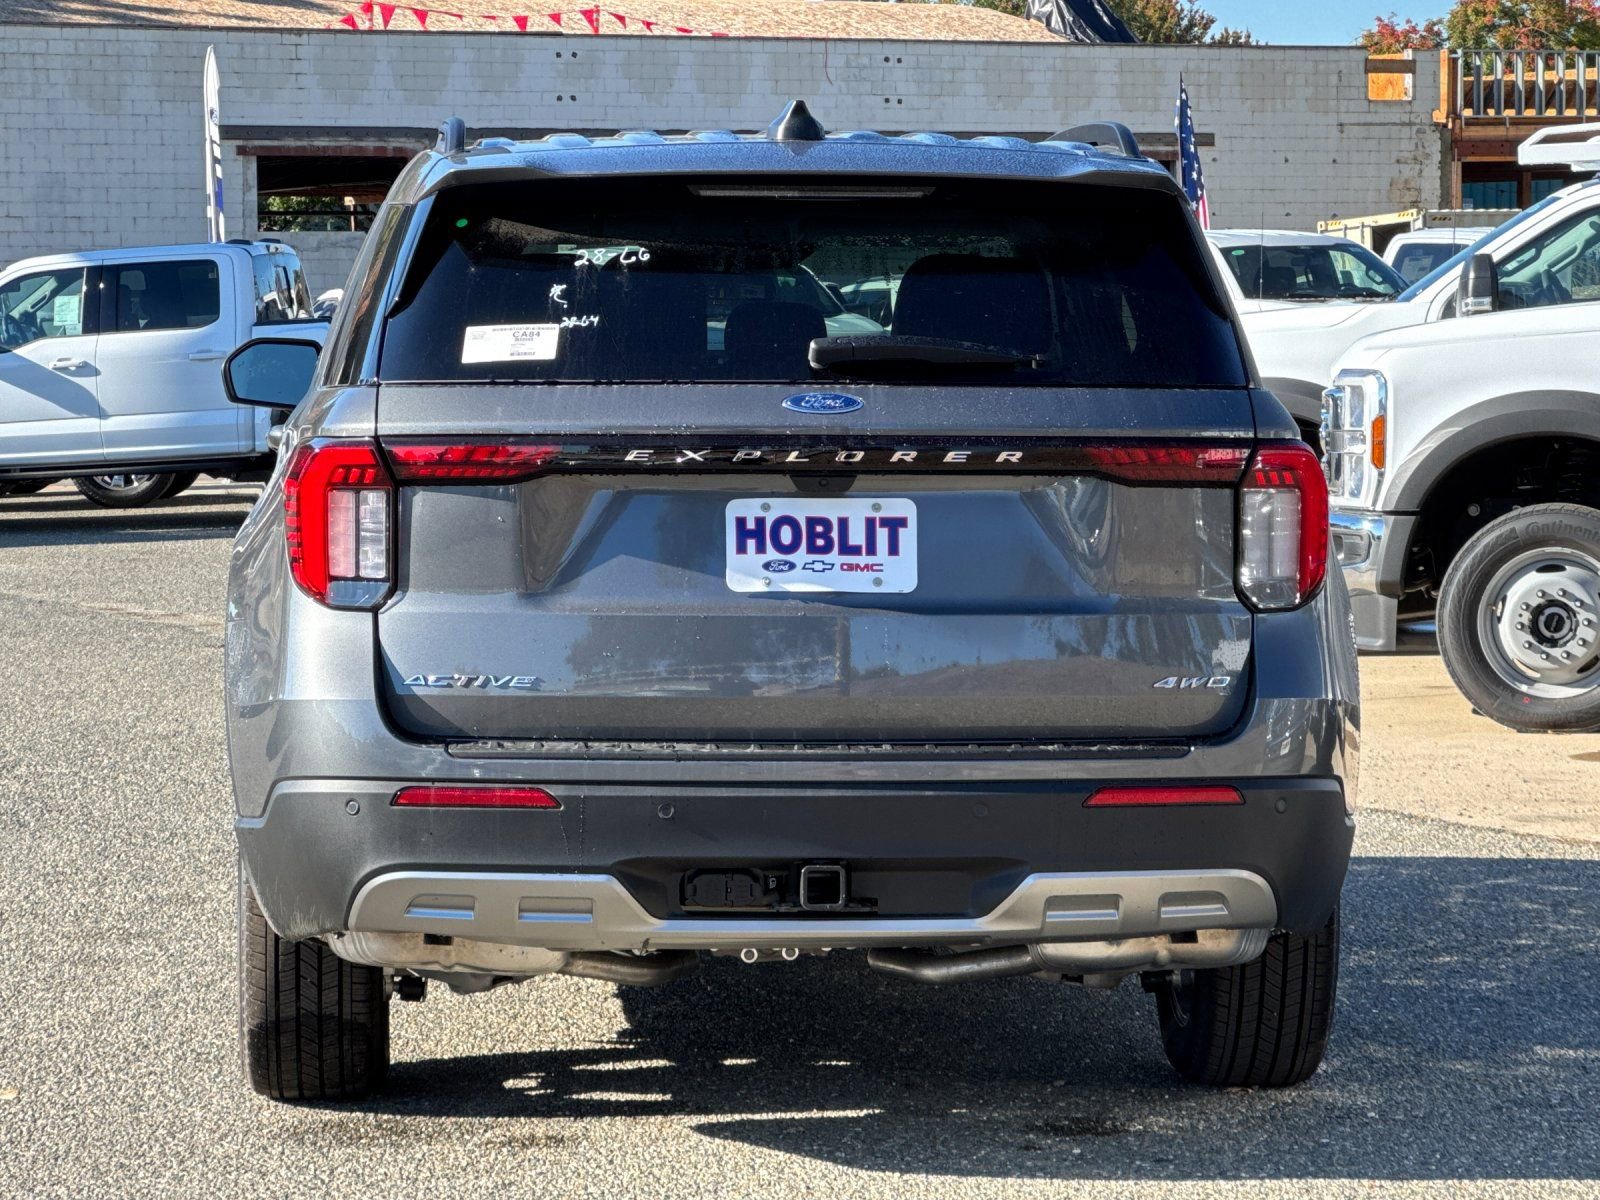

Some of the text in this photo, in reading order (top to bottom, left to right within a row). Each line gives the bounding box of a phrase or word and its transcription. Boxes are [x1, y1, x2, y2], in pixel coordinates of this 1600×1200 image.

[624, 450, 1023, 462] EXPLORER
[735, 514, 908, 556] HOBLIT
[767, 560, 793, 572] Ford
[840, 563, 884, 572] GMC
[403, 674, 537, 687] ACTIVE
[1153, 676, 1231, 688] 4WD
